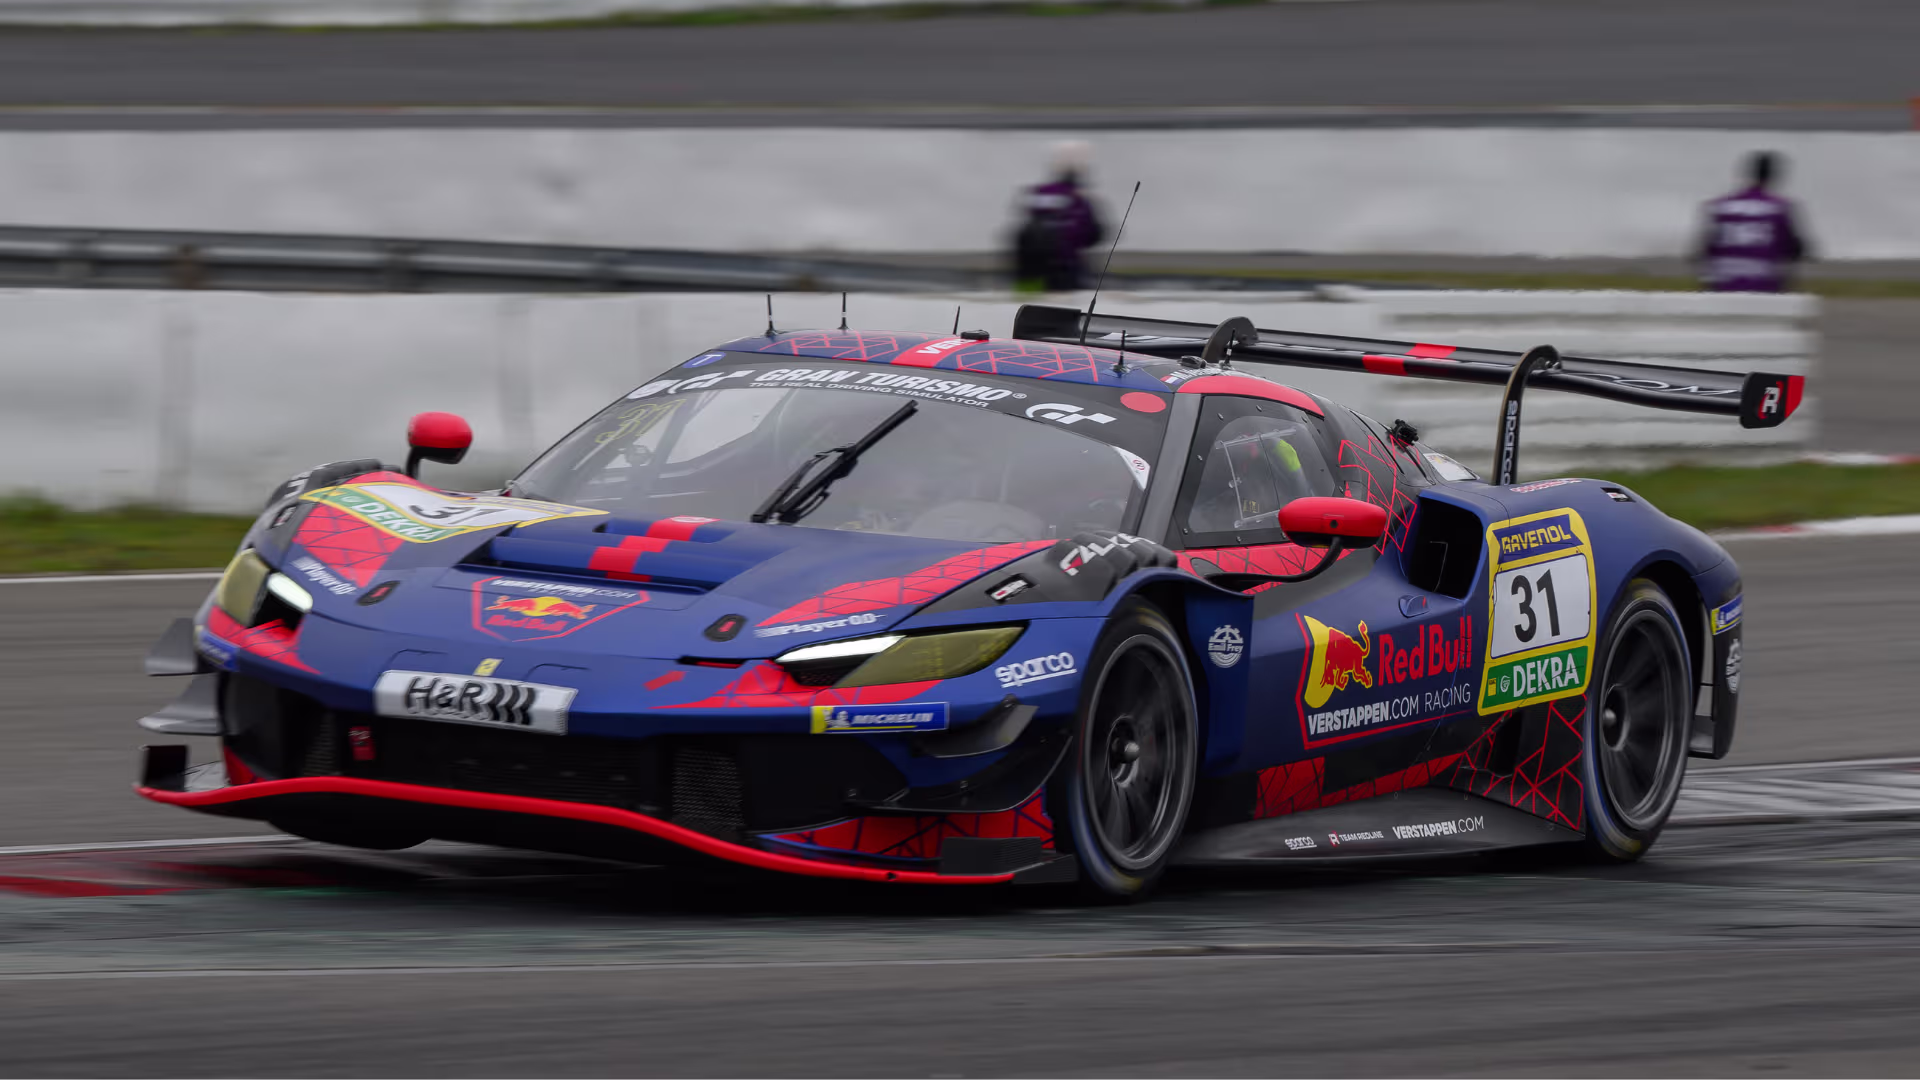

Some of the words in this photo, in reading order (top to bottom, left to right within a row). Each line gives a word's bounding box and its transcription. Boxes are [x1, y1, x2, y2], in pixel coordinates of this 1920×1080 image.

[755, 368, 861, 383] GRAN
[826, 383, 892, 393] DRIVING
[894, 389, 990, 408] SIMULATOR
[1501, 400, 1519, 486] sparco
[352, 502, 447, 541] DEKRA
[1501, 525, 1571, 554] RAVENOL
[1511, 569, 1560, 643] 31
[1378, 625, 1425, 686] Red
[1429, 615, 1472, 676] Bull
[994, 651, 1077, 689] sparco
[1512, 653, 1579, 698] DEKRA
[852, 712, 935, 725] MICHELIN
[1308, 696, 1419, 735] VERSTAPPEN.COM
[1425, 683, 1471, 713] RACING
[1339, 833, 1358, 843] TEAM
[1357, 830, 1384, 841] REDLINE
[1392, 815, 1485, 840] VERSTAPPEN.COM
